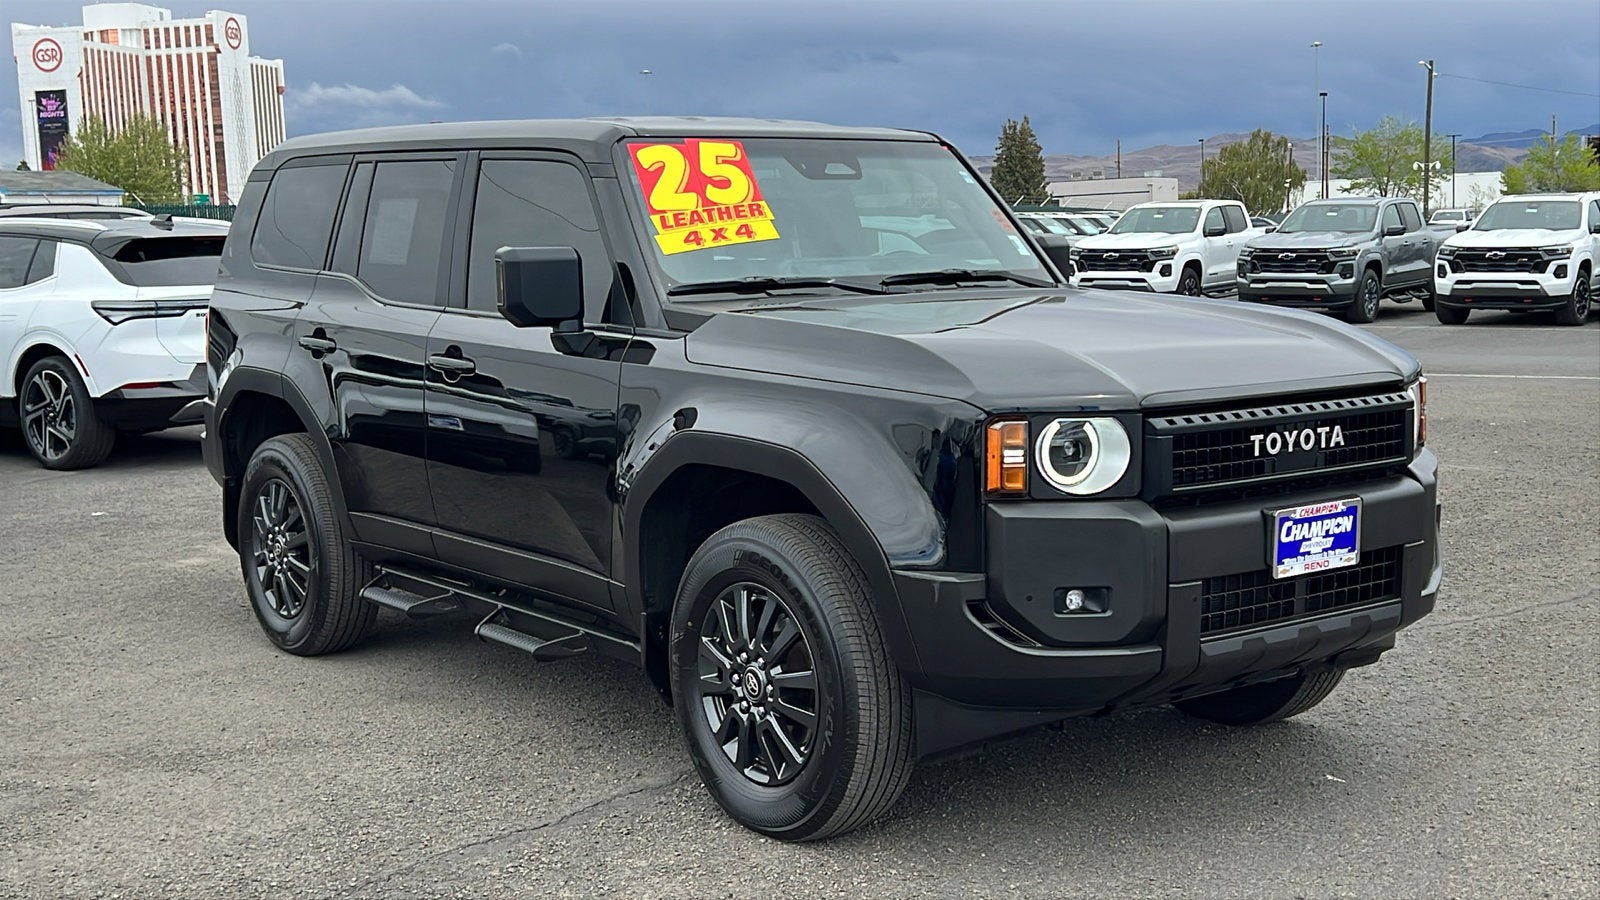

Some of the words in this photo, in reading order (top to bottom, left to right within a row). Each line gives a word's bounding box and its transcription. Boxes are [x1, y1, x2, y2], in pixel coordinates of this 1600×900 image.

[36, 48, 58, 63] GSR
[636, 141, 754, 211] 25
[659, 203, 765, 231] LEATHER
[1250, 425, 1345, 456] TOYOTA
[1299, 503, 1340, 517] CHAMPION
[1280, 515, 1354, 543] CHAMPION
[1303, 560, 1330, 571] RENO
